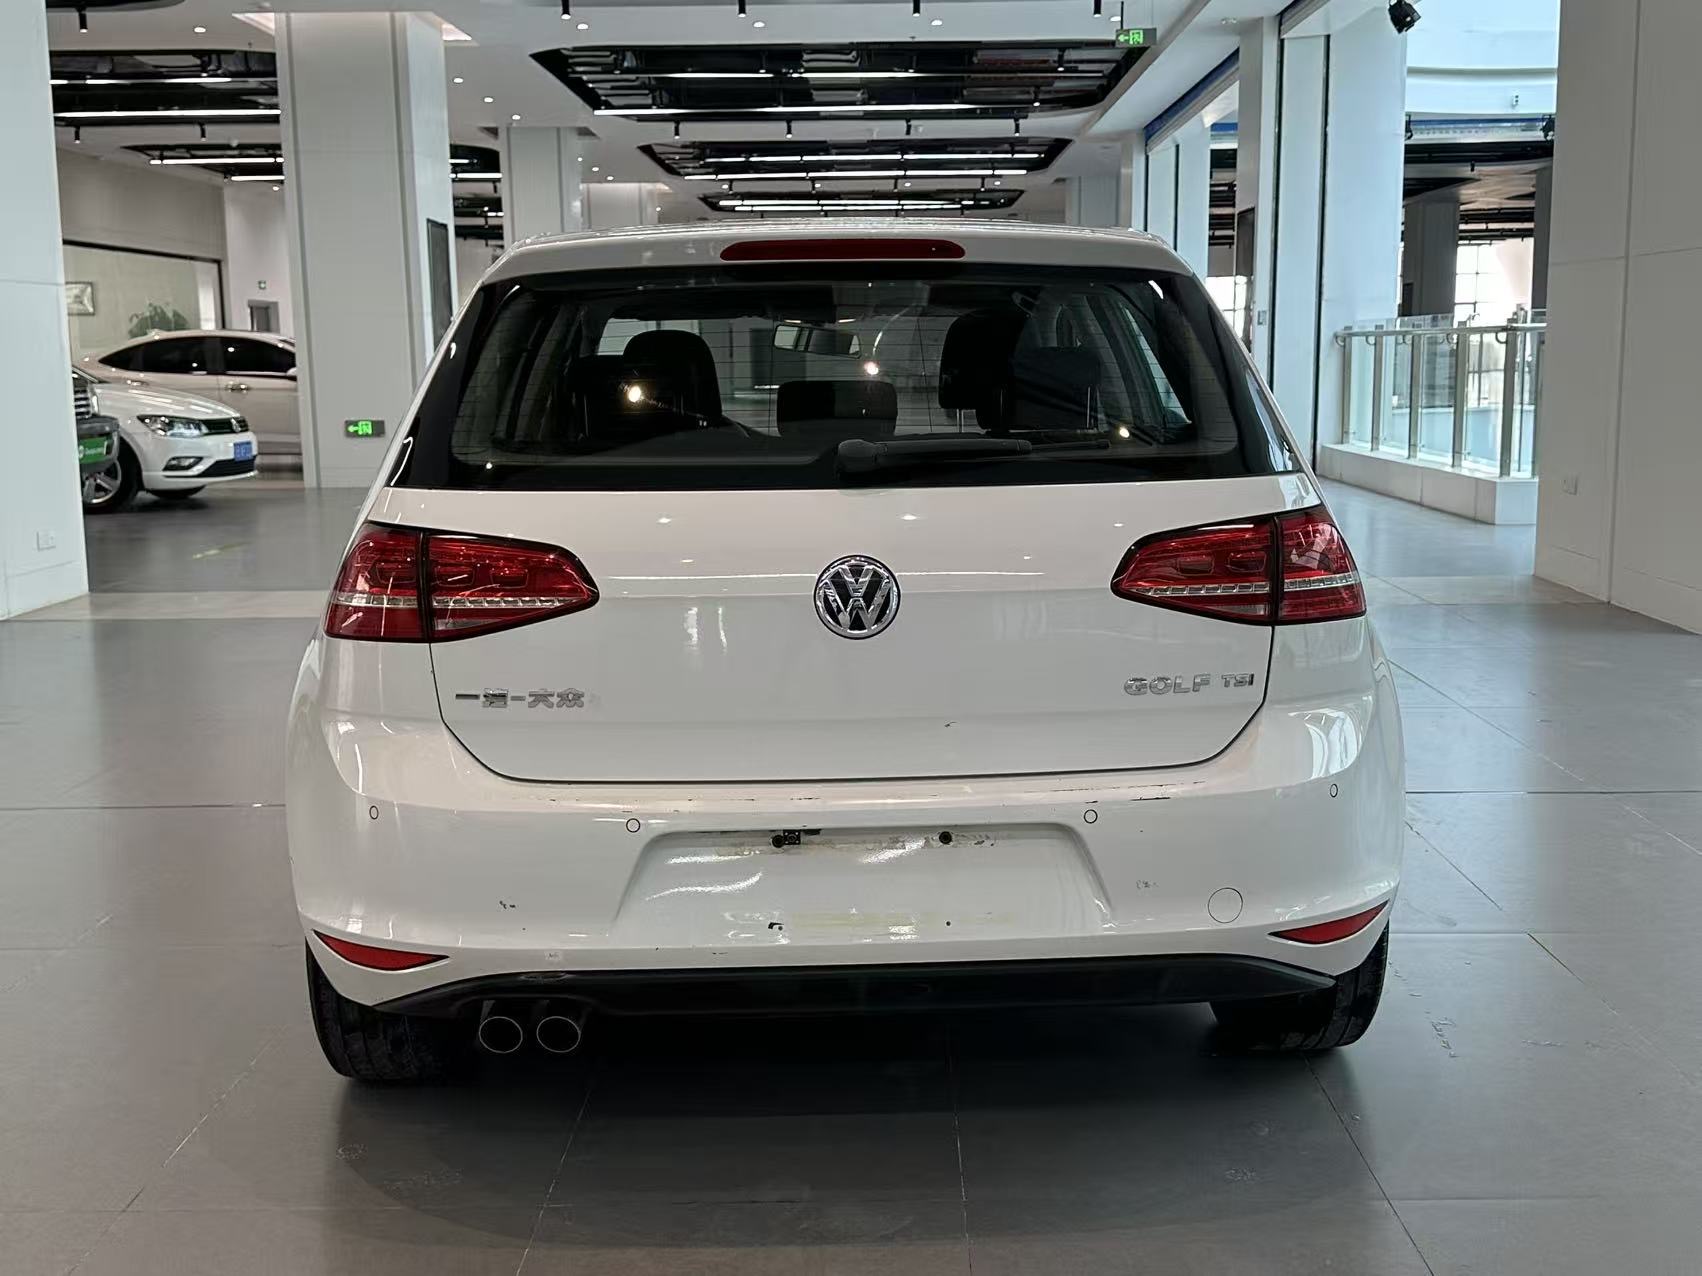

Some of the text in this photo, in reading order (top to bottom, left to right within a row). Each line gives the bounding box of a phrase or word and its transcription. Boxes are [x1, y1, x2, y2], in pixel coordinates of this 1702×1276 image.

[817, 559, 897, 635] VW
[1123, 673, 1255, 696] GOLF TSI
